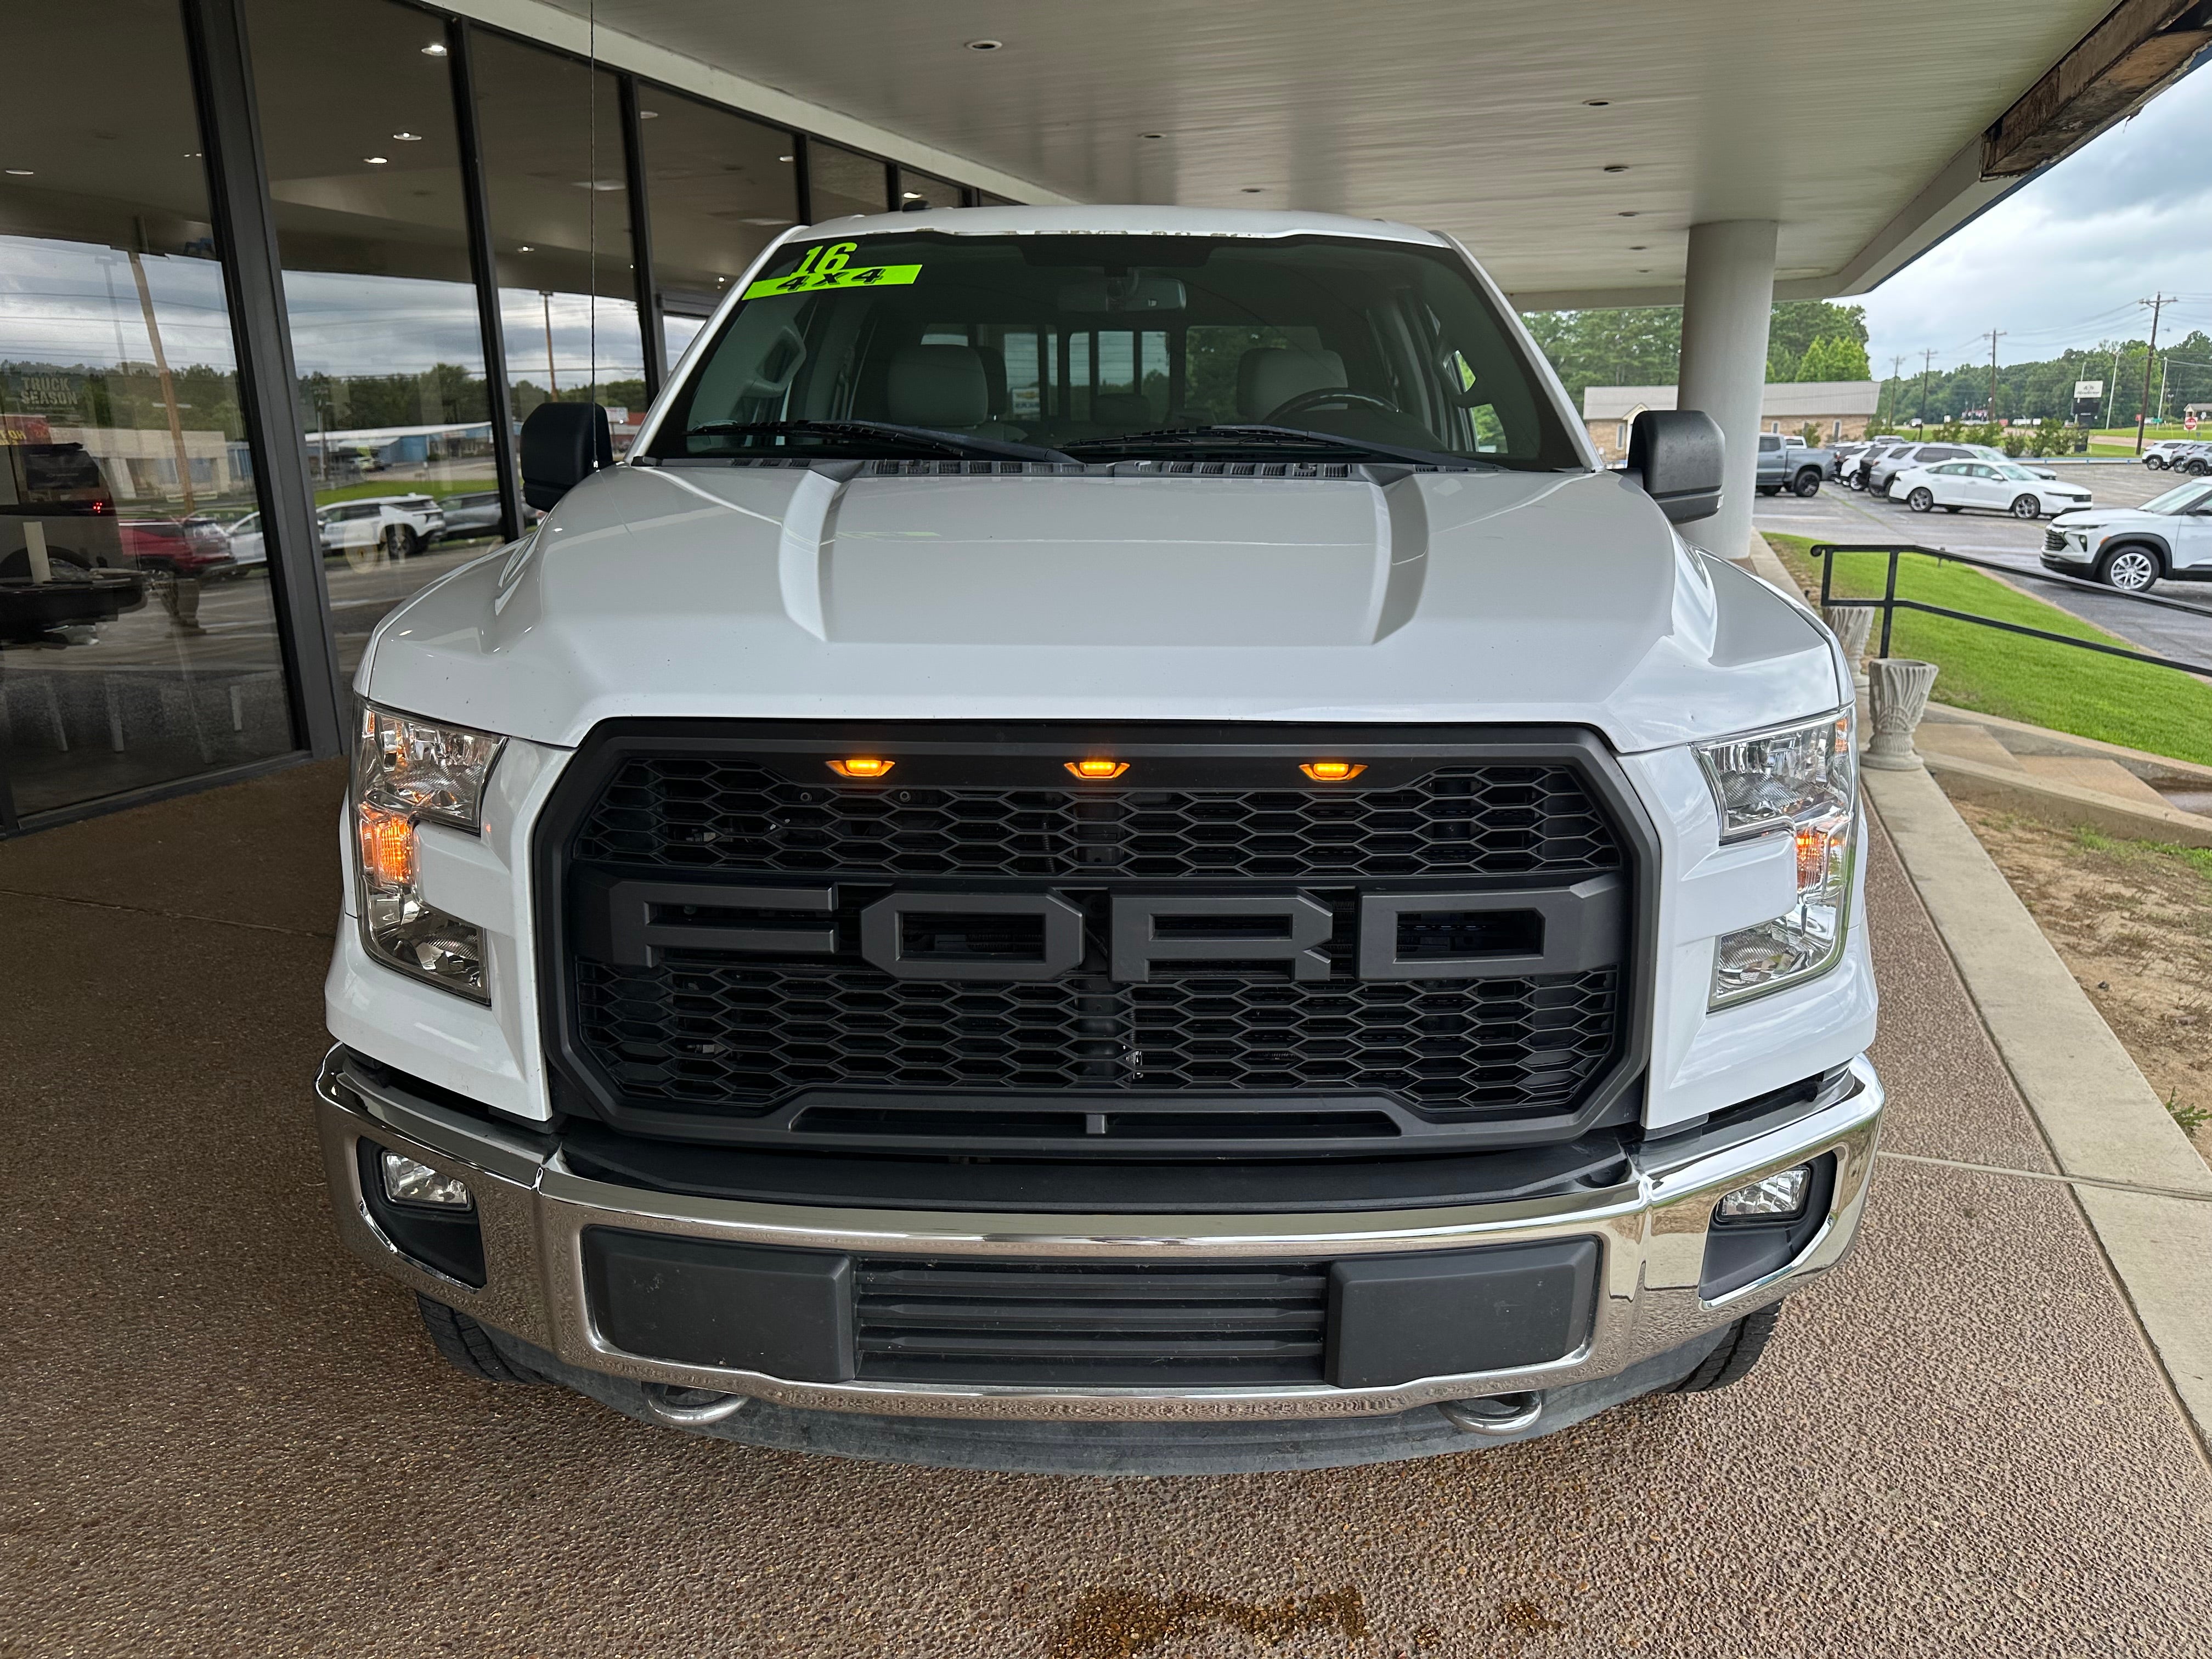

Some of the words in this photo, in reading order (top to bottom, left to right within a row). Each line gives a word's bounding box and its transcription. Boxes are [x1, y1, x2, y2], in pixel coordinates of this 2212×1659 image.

[789, 242, 858, 276] 16
[21, 377, 70, 391] TRUCK
[20, 391, 78, 404] SEASON
[608, 877, 1621, 983] FORD
